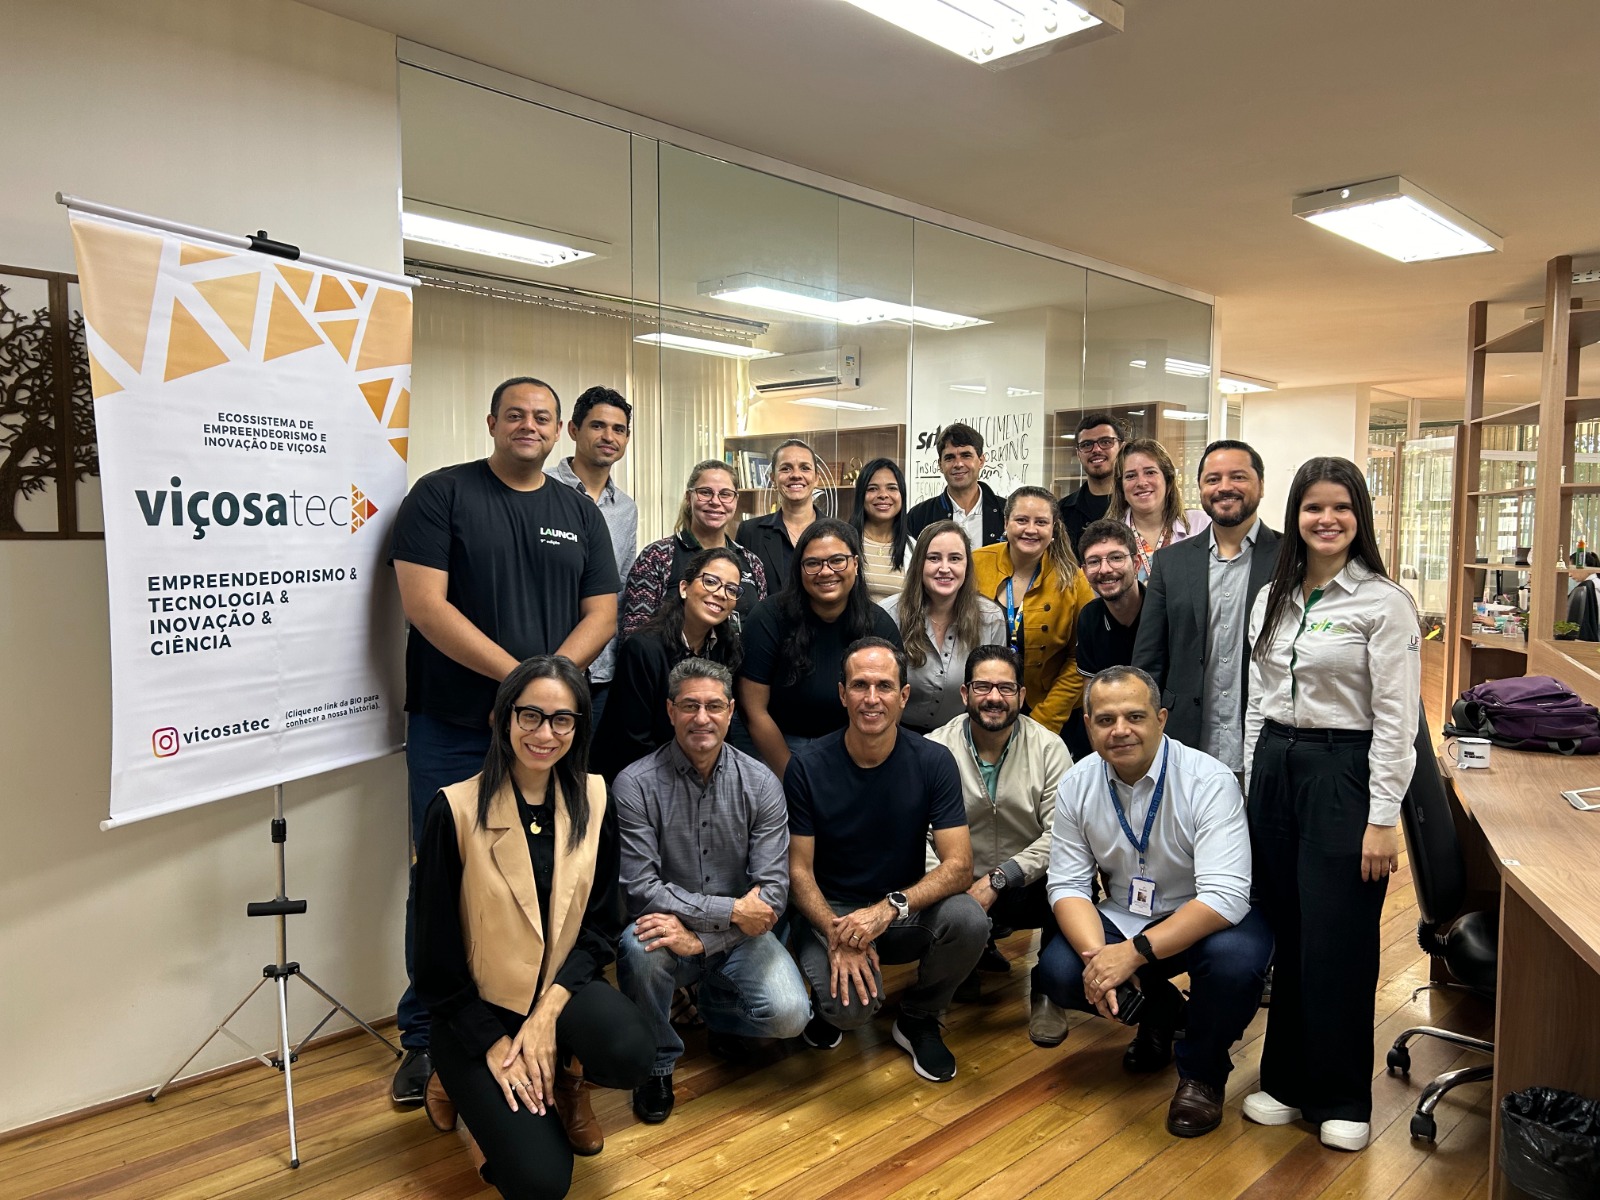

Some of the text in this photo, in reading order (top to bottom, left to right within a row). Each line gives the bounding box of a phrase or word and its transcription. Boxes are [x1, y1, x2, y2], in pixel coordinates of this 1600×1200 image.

[218, 412, 314, 429] ECOSSISTEMA DE
[203, 424, 327, 442] EMPREENDEORISMO E
[204, 437, 326, 454] INOVAÇÃO DE VIÇOSA
[134, 476, 348, 540] viçosatec
[148, 567, 358, 592] EMPREENDEDORISMO &
[148, 590, 289, 613] TECNOLOGIA &
[150, 609, 272, 634] INOVAÇÃO &
[150, 634, 232, 656] CIÊNCIA
[285, 708, 312, 719] (Clique
[324, 701, 338, 711] link
[350, 697, 362, 705] BIO
[363, 694, 379, 704] para
[285, 715, 319, 728] conhecer
[327, 709, 347, 719] nossa
[183, 717, 270, 744] vicosatec
